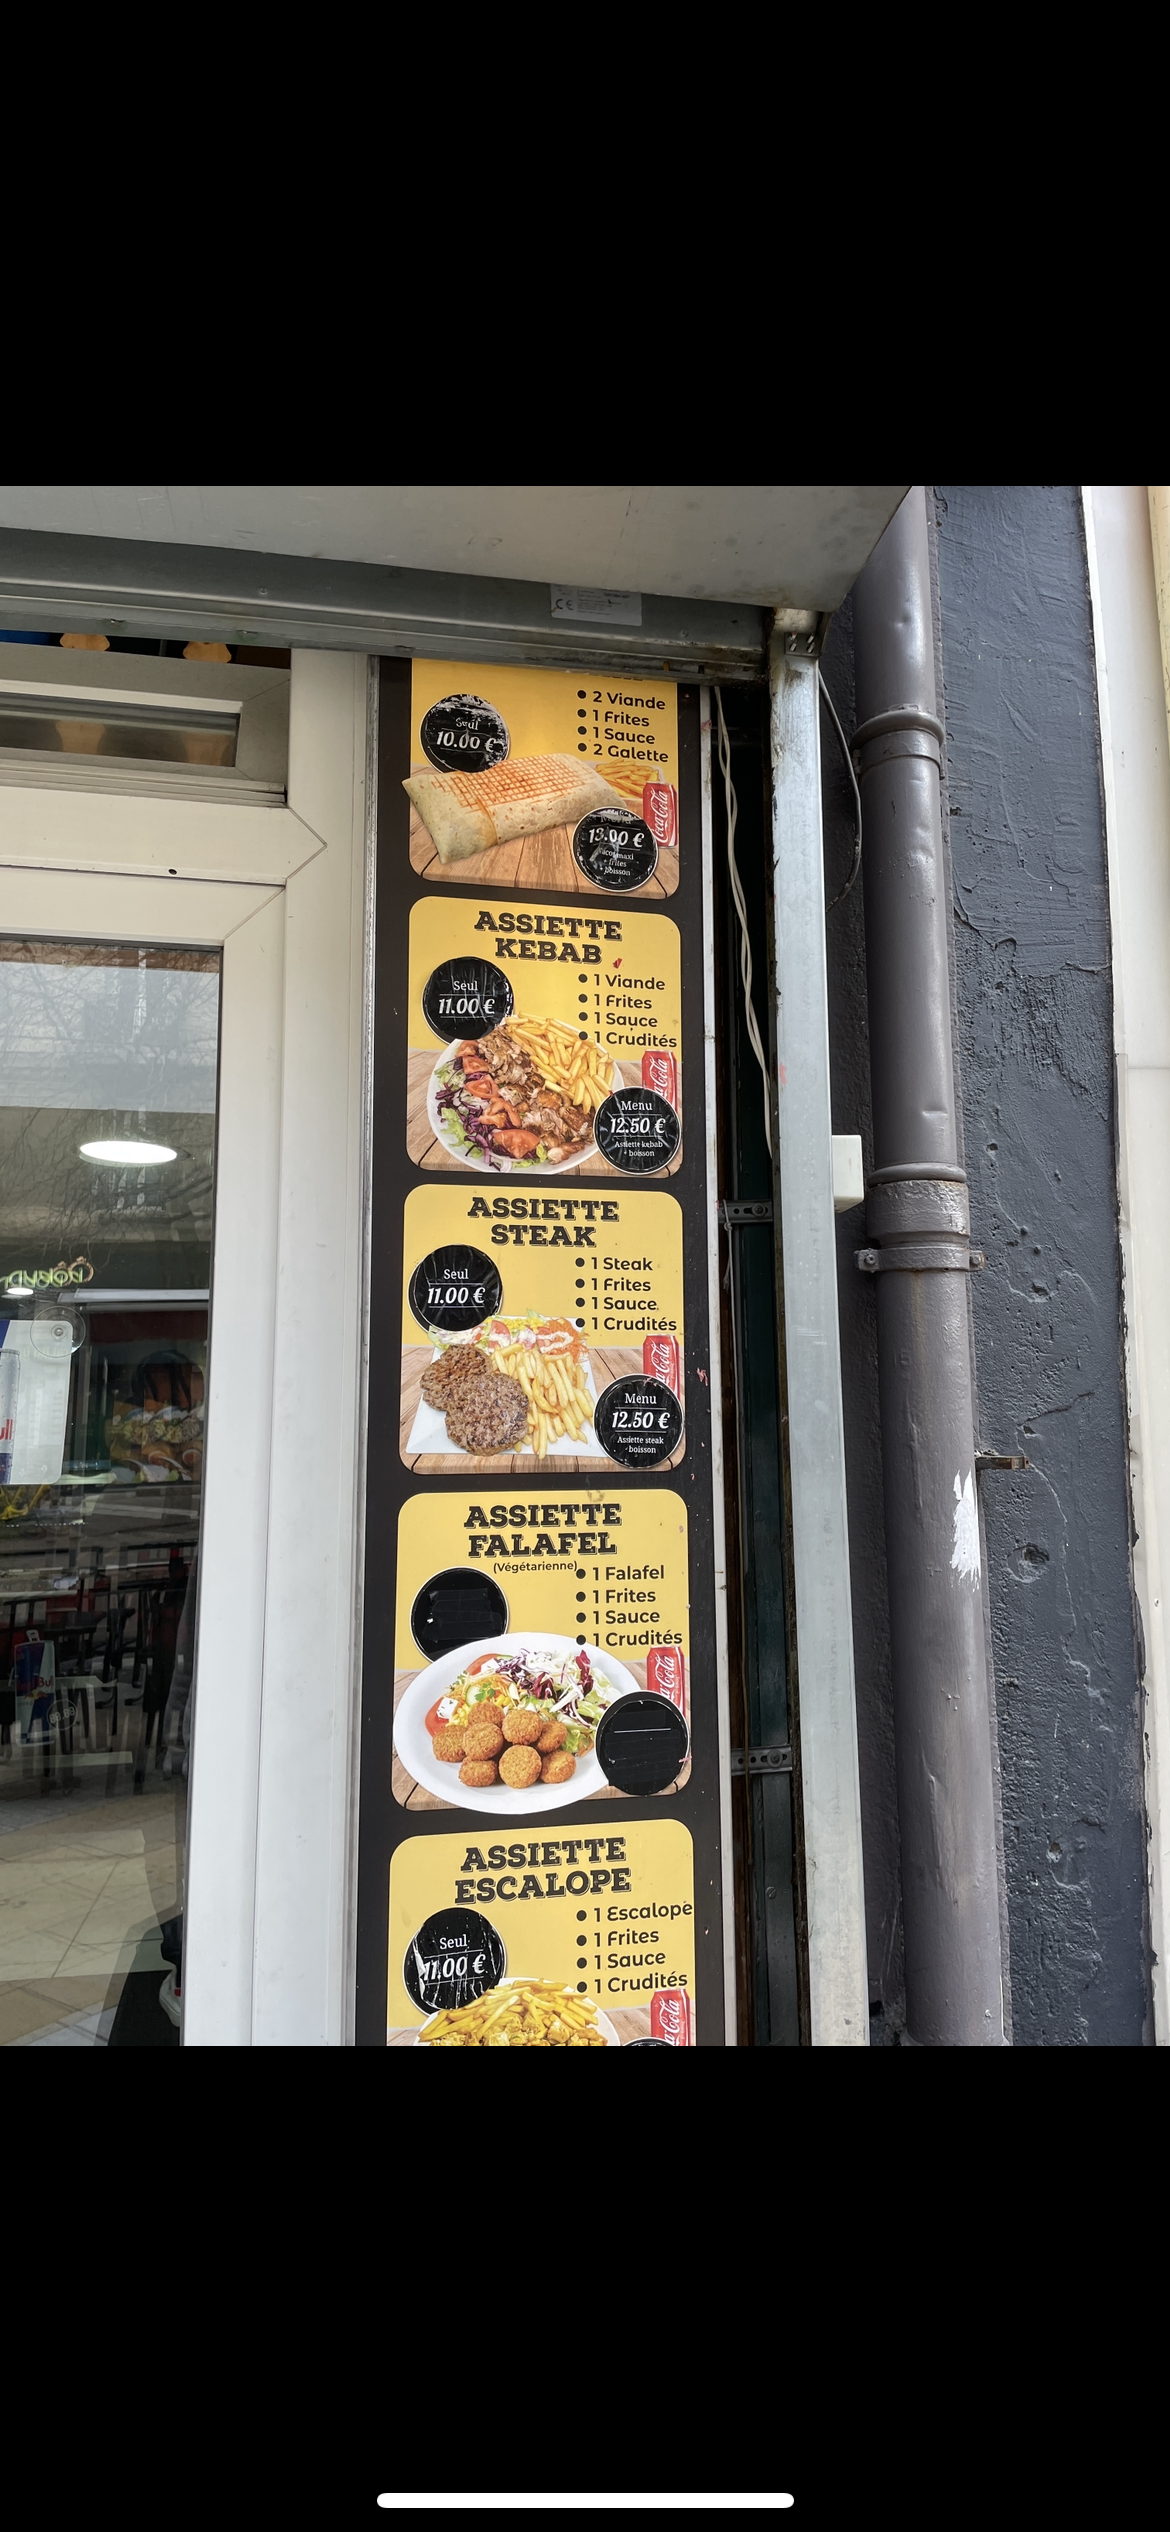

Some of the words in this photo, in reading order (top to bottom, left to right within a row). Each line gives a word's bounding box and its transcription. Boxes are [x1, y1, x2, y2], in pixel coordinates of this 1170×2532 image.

[592, 690, 603, 703] 2
[606, 691, 666, 710] Viande
[455, 717, 479, 730] Seul
[592, 709, 599, 721] 1
[604, 711, 650, 727] Frites
[436, 731, 480, 749] 10.00
[592, 726, 599, 738] 1
[604, 727, 655, 744] Sauce
[593, 743, 603, 755] 2
[607, 745, 669, 762] Galette
[588, 827, 629, 846] 13.00
[632, 832, 645, 848] €
[608, 858, 627, 867] frites
[474, 910, 623, 941] ASSIETTE
[495, 937, 602, 965] KEBAB
[453, 980, 478, 991] Seul
[594, 973, 600, 986] 1
[605, 974, 666, 990] Viande
[438, 998, 479, 1015] 11.00
[482, 998, 495, 1014] €
[594, 993, 600, 1006] 1
[606, 994, 652, 1009] Frites
[594, 1011, 600, 1024] 1
[606, 1012, 658, 1027] Sauce
[594, 1031, 600, 1043] 1
[606, 1031, 677, 1047] Crudités
[620, 1100, 653, 1111] Menu
[610, 1117, 651, 1134] 12.50
[654, 1117, 666, 1134] €
[641, 1140, 663, 1148] kebab
[467, 1196, 620, 1222] ASSIETTE
[491, 1223, 597, 1248] STEAK
[591, 1256, 598, 1270] 1
[603, 1257, 653, 1271] Steak
[443, 1268, 469, 1280] Seul
[591, 1277, 598, 1291] 1
[603, 1277, 651, 1292] Frites
[427, 1286, 469, 1304] 11.00
[472, 1287, 486, 1304] €
[591, 1296, 598, 1310] 1
[603, 1296, 657, 1310] Sauce
[591, 1317, 598, 1330] 1
[603, 1316, 677, 1331] Crudités
[624, 1392, 657, 1405] Menu
[611, 1411, 654, 1429] 12.50
[657, 1412, 671, 1429] €
[617, 1436, 644, 1444] Assiette
[644, 1436, 664, 1444] steak
[628, 1445, 657, 1454] boisson
[463, 1502, 622, 1529] ASSIETTE
[467, 1531, 618, 1559] FALAFEL
[493, 1560, 578, 1574] (Végétarienne)
[592, 1567, 599, 1581] 1
[605, 1564, 665, 1580] Falafel
[592, 1590, 599, 1604] 1
[605, 1588, 656, 1604] Frites
[592, 1610, 599, 1625] 1
[605, 1610, 660, 1625] Sauce
[593, 1633, 599, 1647] 1
[605, 1629, 683, 1646] Crudités
[460, 1836, 627, 1873] ASSIETTE
[454, 1867, 632, 1905] ESCALOPE
[593, 1907, 600, 1922] 1
[438, 1935, 467, 1950] Seul
[593, 1932, 600, 1947] 1
[607, 1928, 660, 1946] Frites
[422, 1955, 468, 1981] 11.00
[471, 1953, 487, 1975] €
[594, 1954, 601, 1969] 1
[607, 1952, 666, 1969] Sauce
[594, 1978, 601, 1994] 1
[607, 1970, 688, 1993] Crudités
